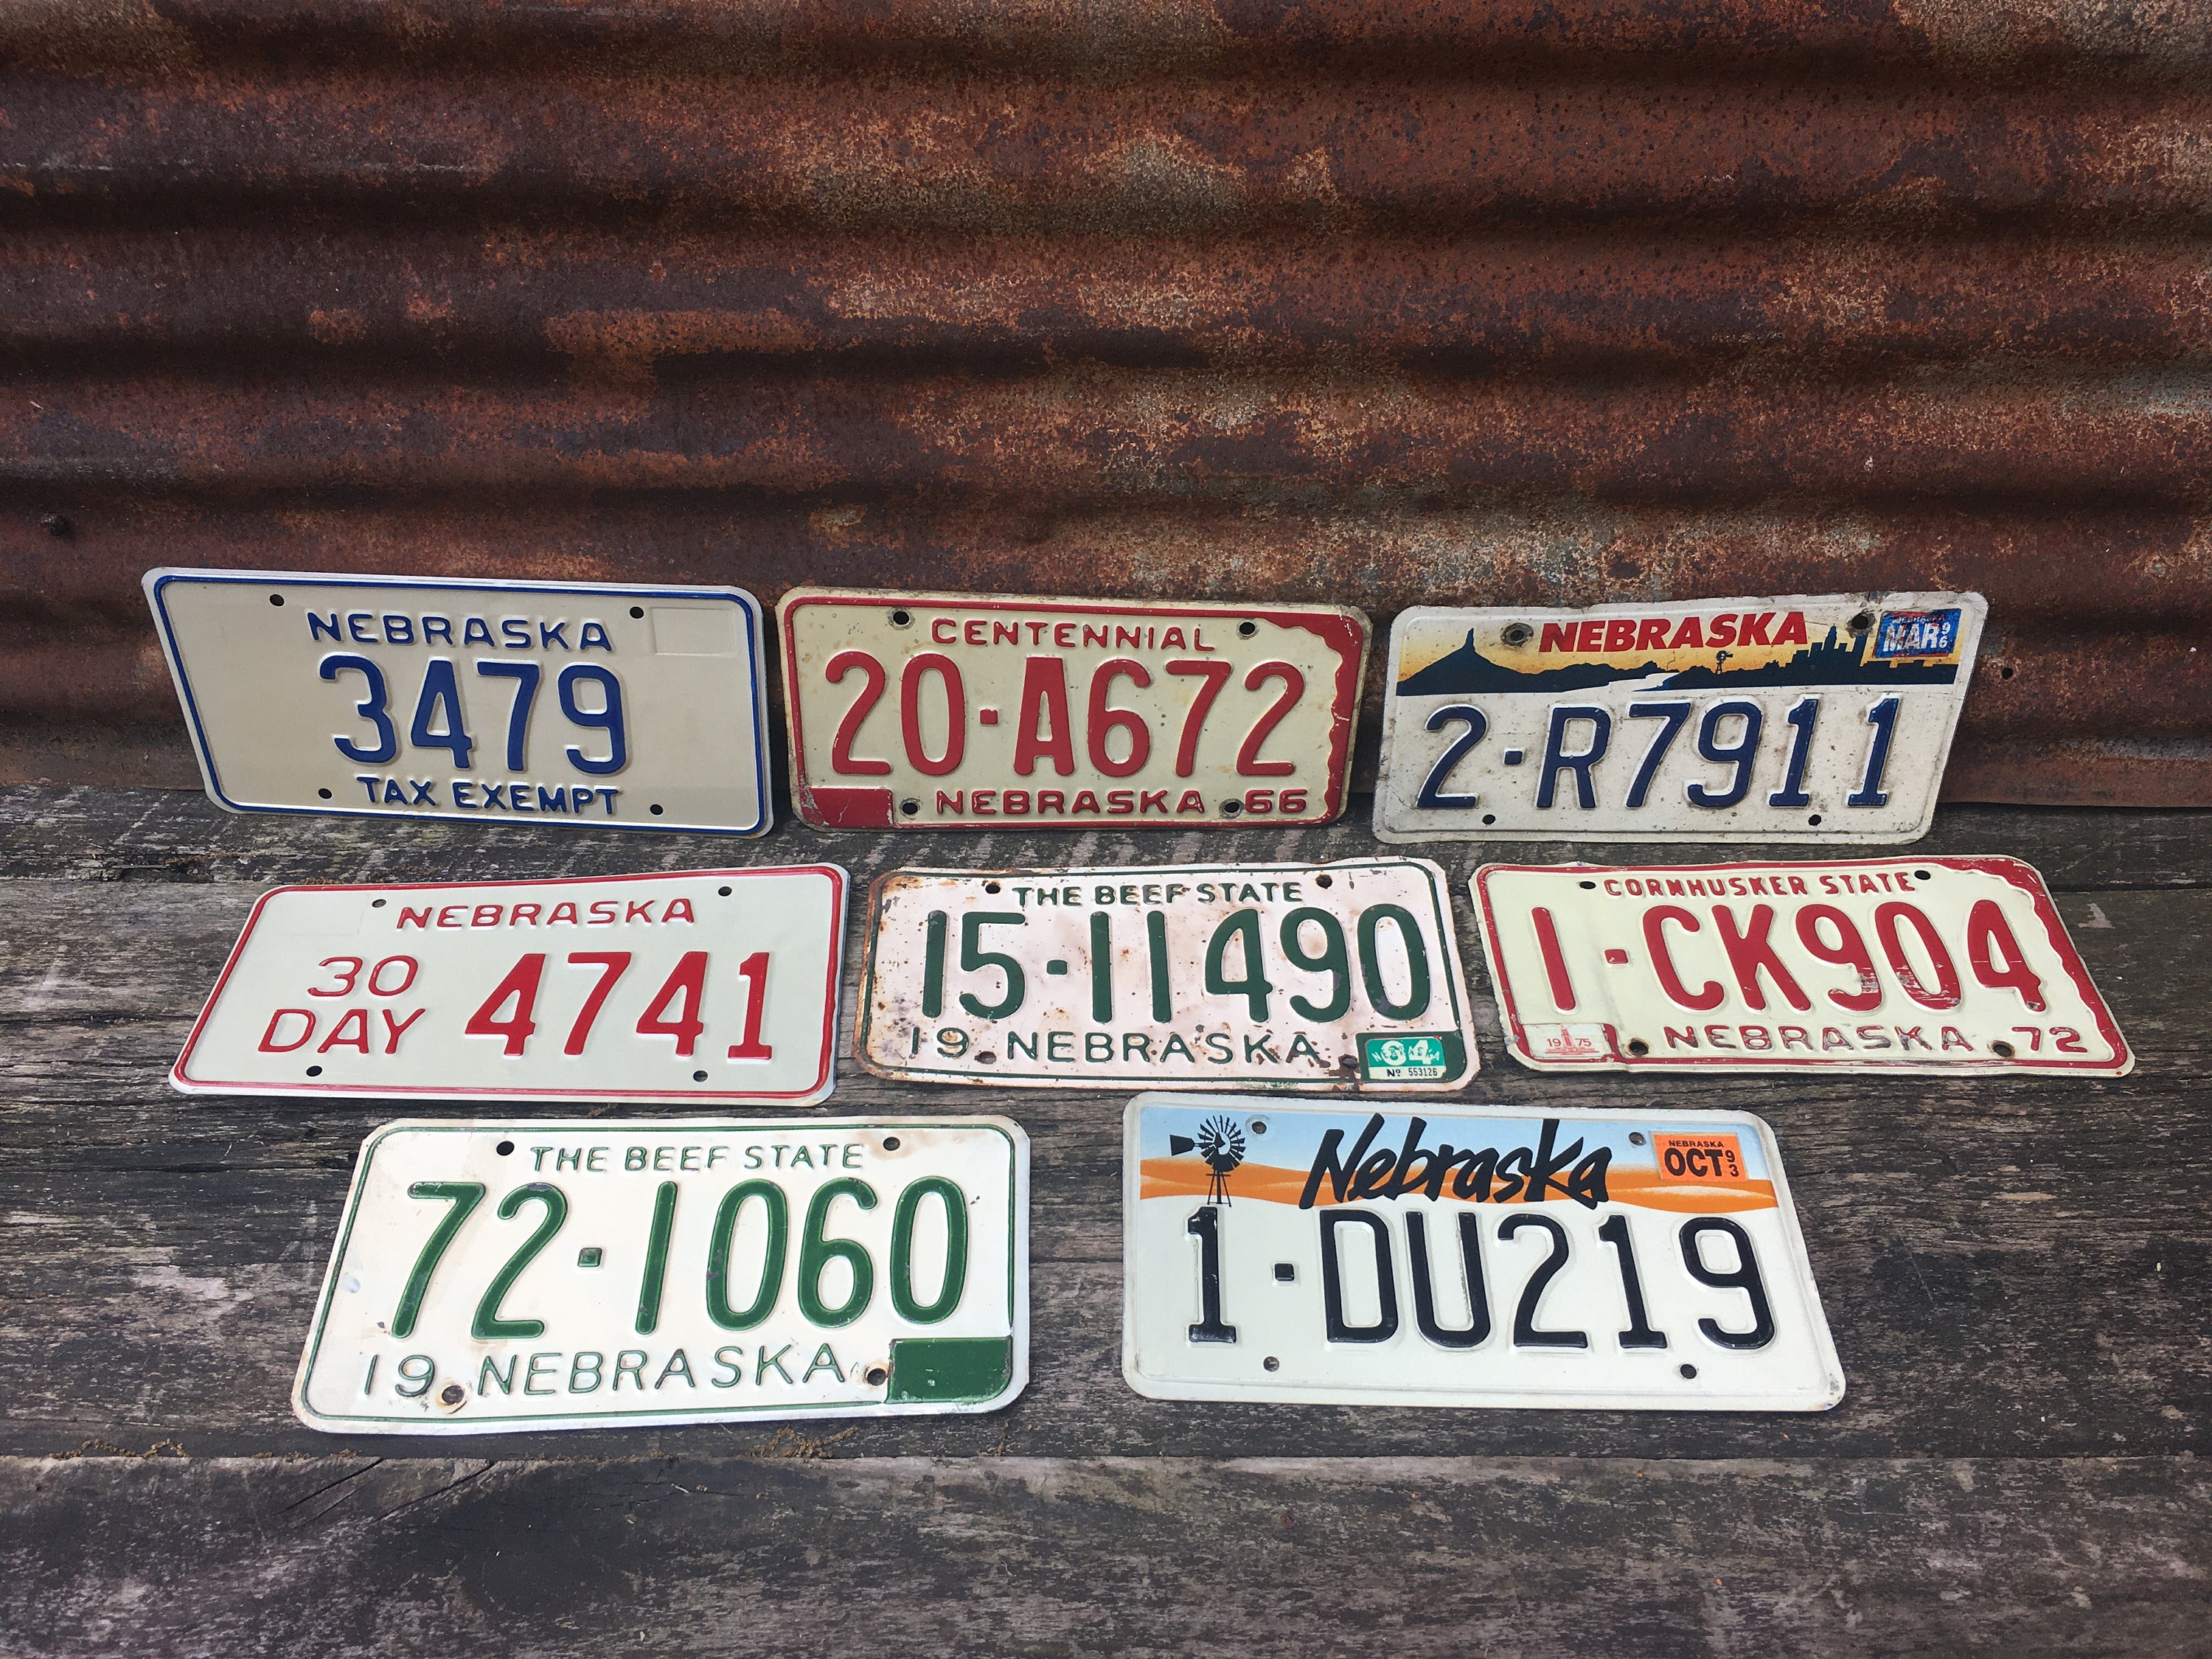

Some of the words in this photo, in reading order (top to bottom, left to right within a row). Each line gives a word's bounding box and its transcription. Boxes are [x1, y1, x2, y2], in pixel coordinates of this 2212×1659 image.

[307, 612, 612, 652] NEBRASKA
[931, 619, 1214, 652] CENTENNIAL
[1539, 612, 1807, 653] NEBRASKA
[1883, 622, 1940, 652] MAR
[319, 654, 626, 775] 3479
[357, 776, 437, 807] TAX
[455, 782, 620, 815] EXEMPT
[936, 790, 1205, 815] NEBRASKA
[1245, 790, 1307, 813] 66
[1012, 886, 1080, 907] THE
[1095, 886, 1184, 906] BEEF
[1197, 882, 1304, 903] STATE
[1604, 876, 1808, 897] CORNHUSKER
[1818, 872, 1916, 893] STATE
[397, 898, 695, 929] NEBRASKA
[308, 956, 418, 997] 30
[465, 951, 772, 1060] 4741
[258, 1008, 426, 1054] DAY
[911, 1026, 968, 1058] 19
[1006, 1032, 1326, 1065] NEBRASKA
[1547, 1038, 1561, 1046] 19
[1575, 1038, 1591, 1046] 75
[1666, 1026, 1974, 1051] NEBRASKA
[2012, 1026, 2088, 1053] 72
[1408, 1068, 1437, 1076] 553126
[531, 1147, 607, 1172] THE
[625, 1146, 727, 1171] BEEF
[745, 1144, 863, 1169] STATE
[1299, 1113, 1613, 1209] Nebraska
[1665, 1148, 1722, 1177] OCT
[364, 1354, 436, 1398] 19
[478, 1343, 845, 1397] NEBRASKA
